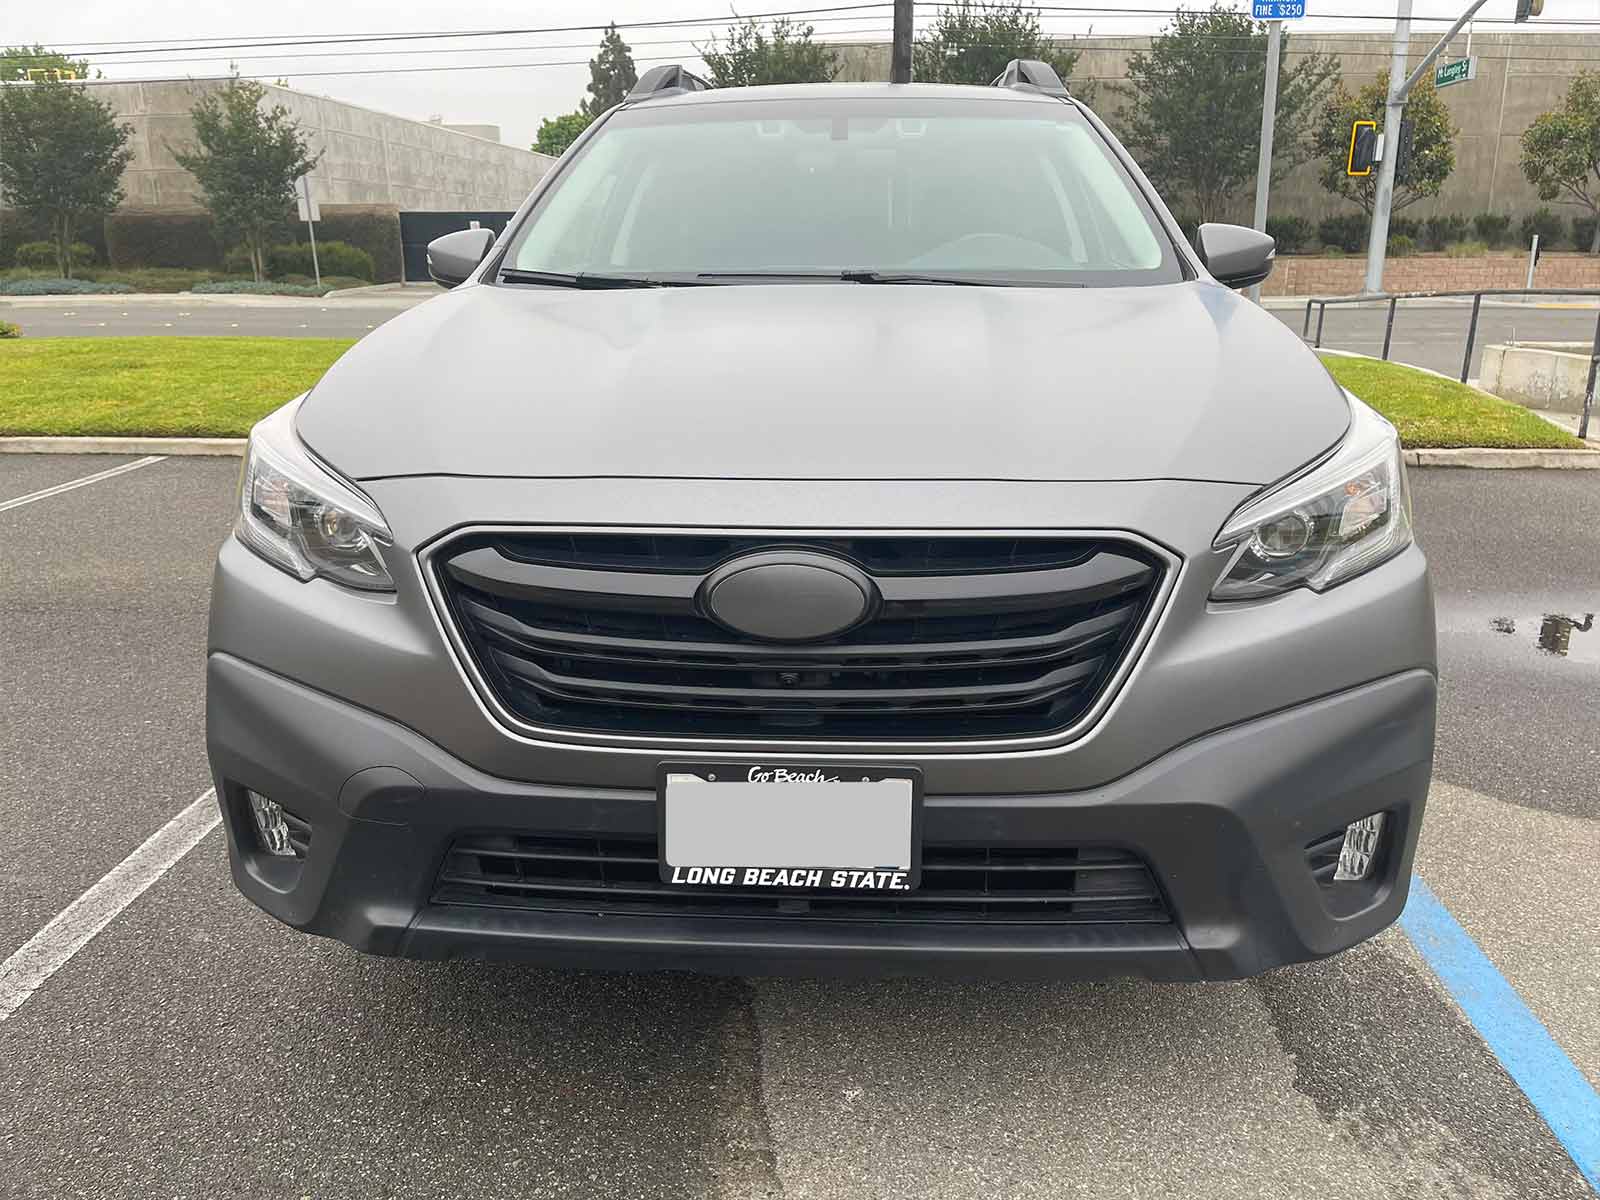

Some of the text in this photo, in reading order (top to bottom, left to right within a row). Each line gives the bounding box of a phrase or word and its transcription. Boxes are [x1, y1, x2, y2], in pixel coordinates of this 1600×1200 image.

[1255, 4, 1302, 16] FINE $250
[747, 766, 828, 783] Go Beach
[671, 867, 911, 890] LONG BEACH STATE.
